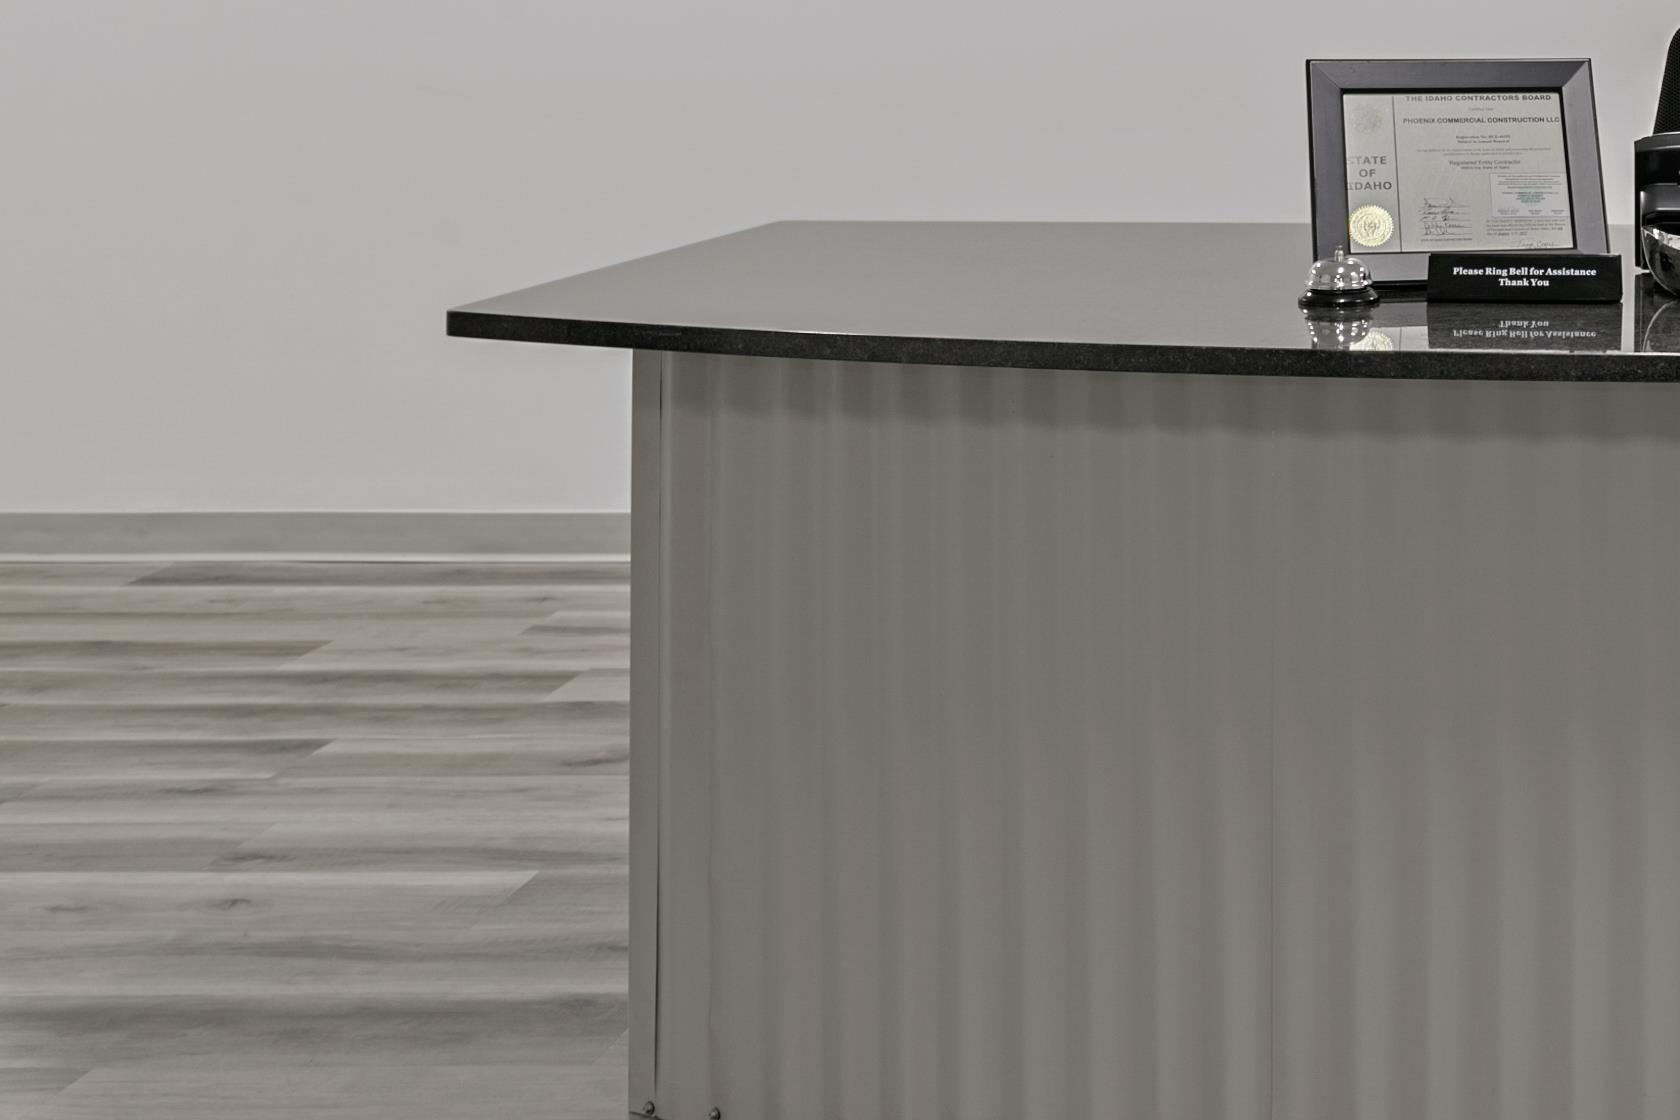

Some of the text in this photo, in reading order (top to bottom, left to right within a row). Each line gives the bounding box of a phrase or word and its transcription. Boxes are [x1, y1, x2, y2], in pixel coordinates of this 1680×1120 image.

[1455, 94, 1520, 102] CONTRACTORS
[1437, 116, 1486, 124] COMMERCIAL
[1358, 168, 1376, 178] OF
[1347, 181, 1392, 191] IDAHO
[1453, 267, 1597, 277] Please Ring Bell for Assistance
[1498, 278, 1550, 287] Thank You
